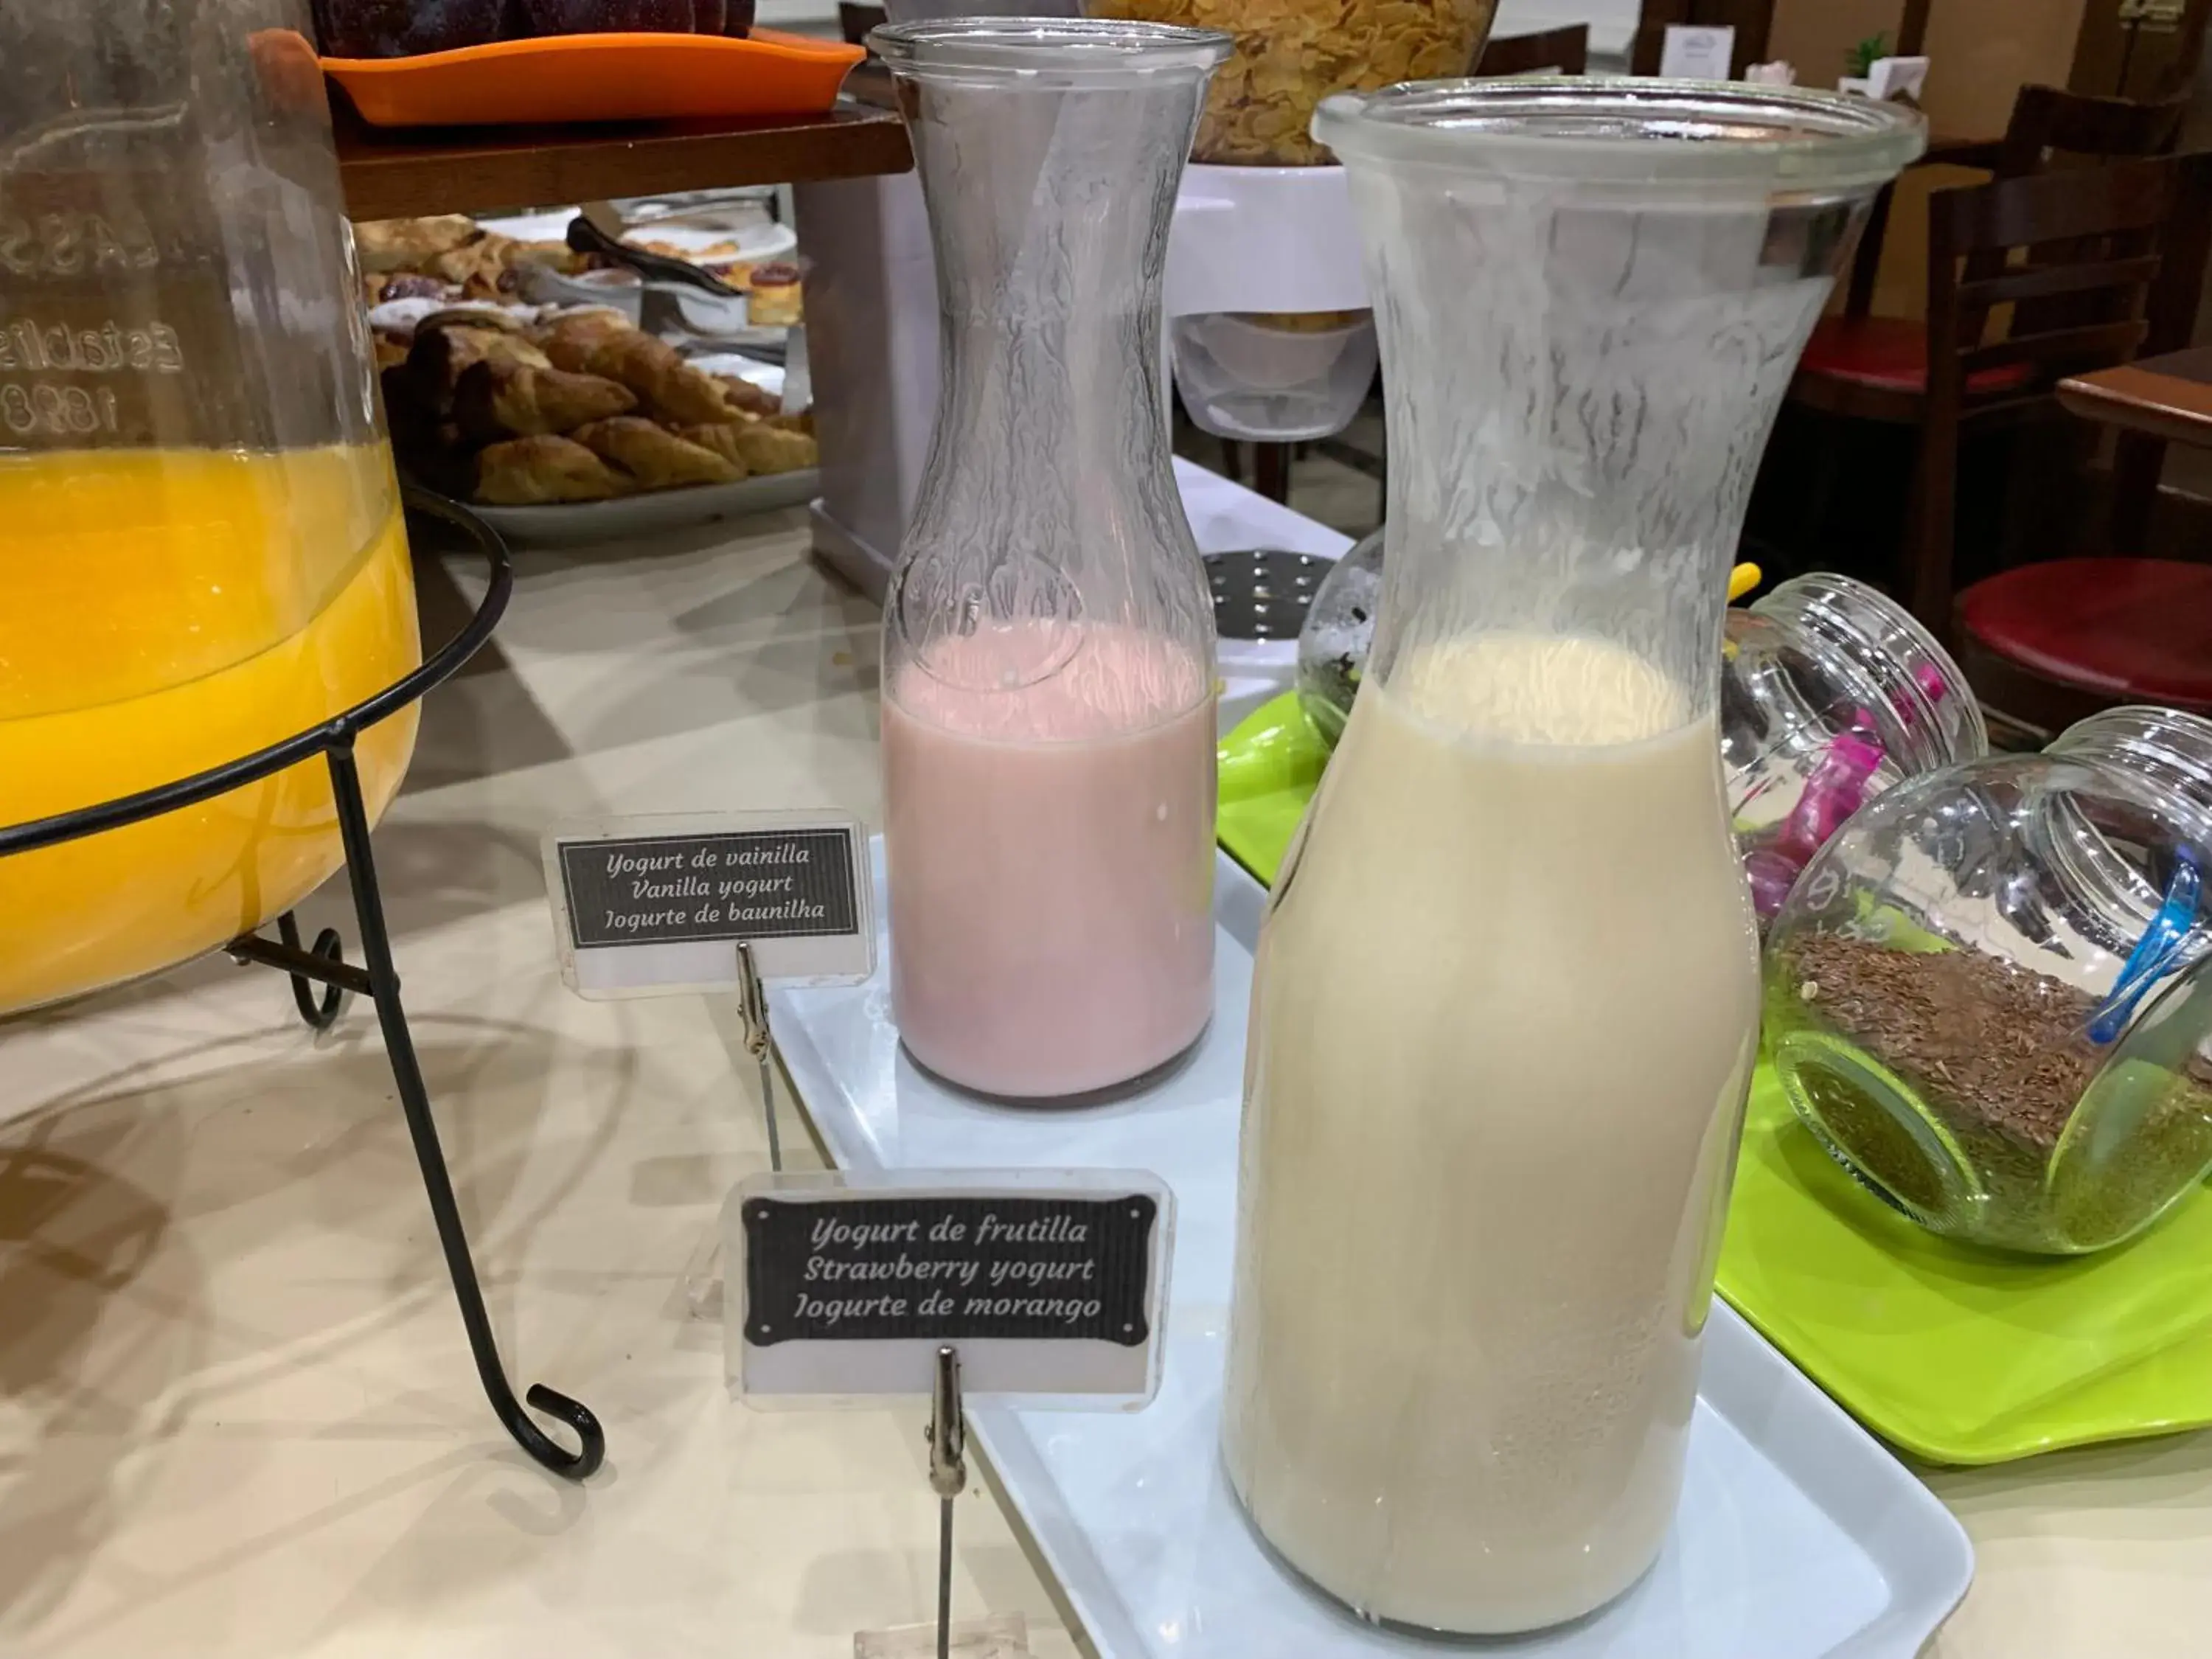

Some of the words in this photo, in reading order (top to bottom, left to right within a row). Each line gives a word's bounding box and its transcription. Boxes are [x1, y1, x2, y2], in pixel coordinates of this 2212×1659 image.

[607, 853, 684, 879] Yogurt
[691, 847, 717, 868] de
[726, 843, 809, 866] vainilla
[632, 876, 710, 900] Vanilla
[718, 876, 793, 899] yogurt
[694, 904, 720, 923] de
[728, 898, 825, 921] baunilha
[811, 1217, 919, 1251] Yogurt
[929, 1214, 966, 1242] de
[974, 1214, 1088, 1245] frutilla
[803, 1254, 980, 1286] Strawberry
[990, 1256, 1096, 1287] yogurt
[917, 1289, 956, 1316] de
[963, 1295, 1102, 1324] morango
